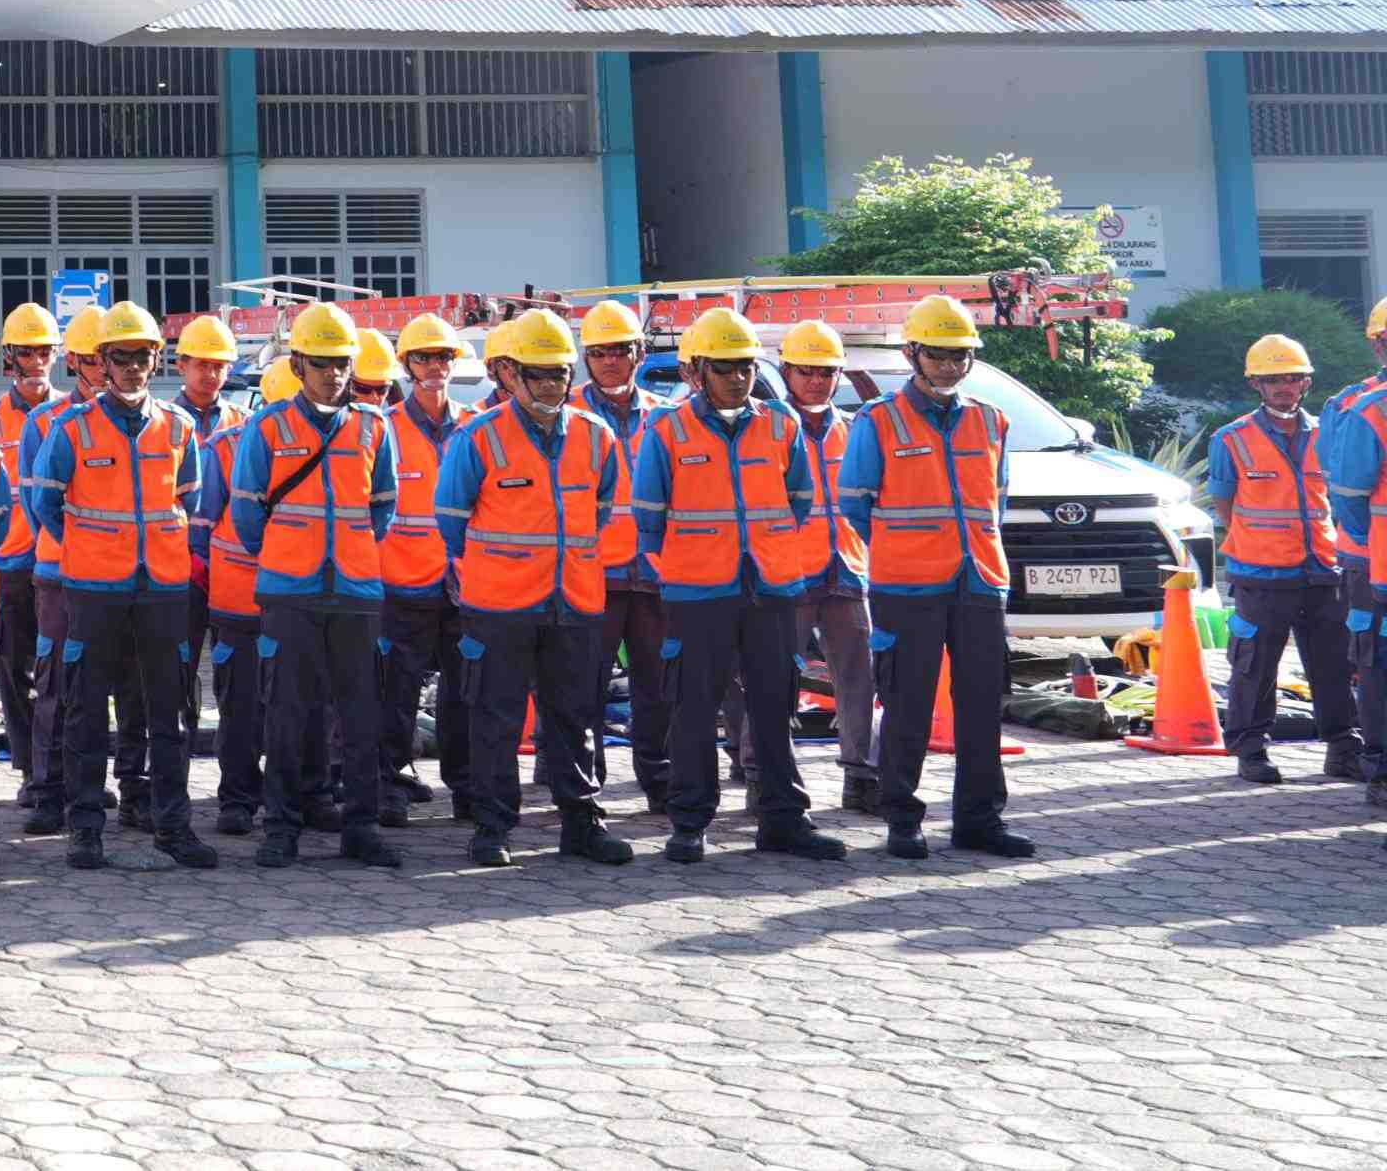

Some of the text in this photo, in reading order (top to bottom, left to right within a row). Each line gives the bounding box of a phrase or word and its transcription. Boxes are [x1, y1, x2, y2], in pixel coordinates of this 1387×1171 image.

[94, 272, 109, 290] P
[1029, 568, 1117, 585] B 2457 PZJ
